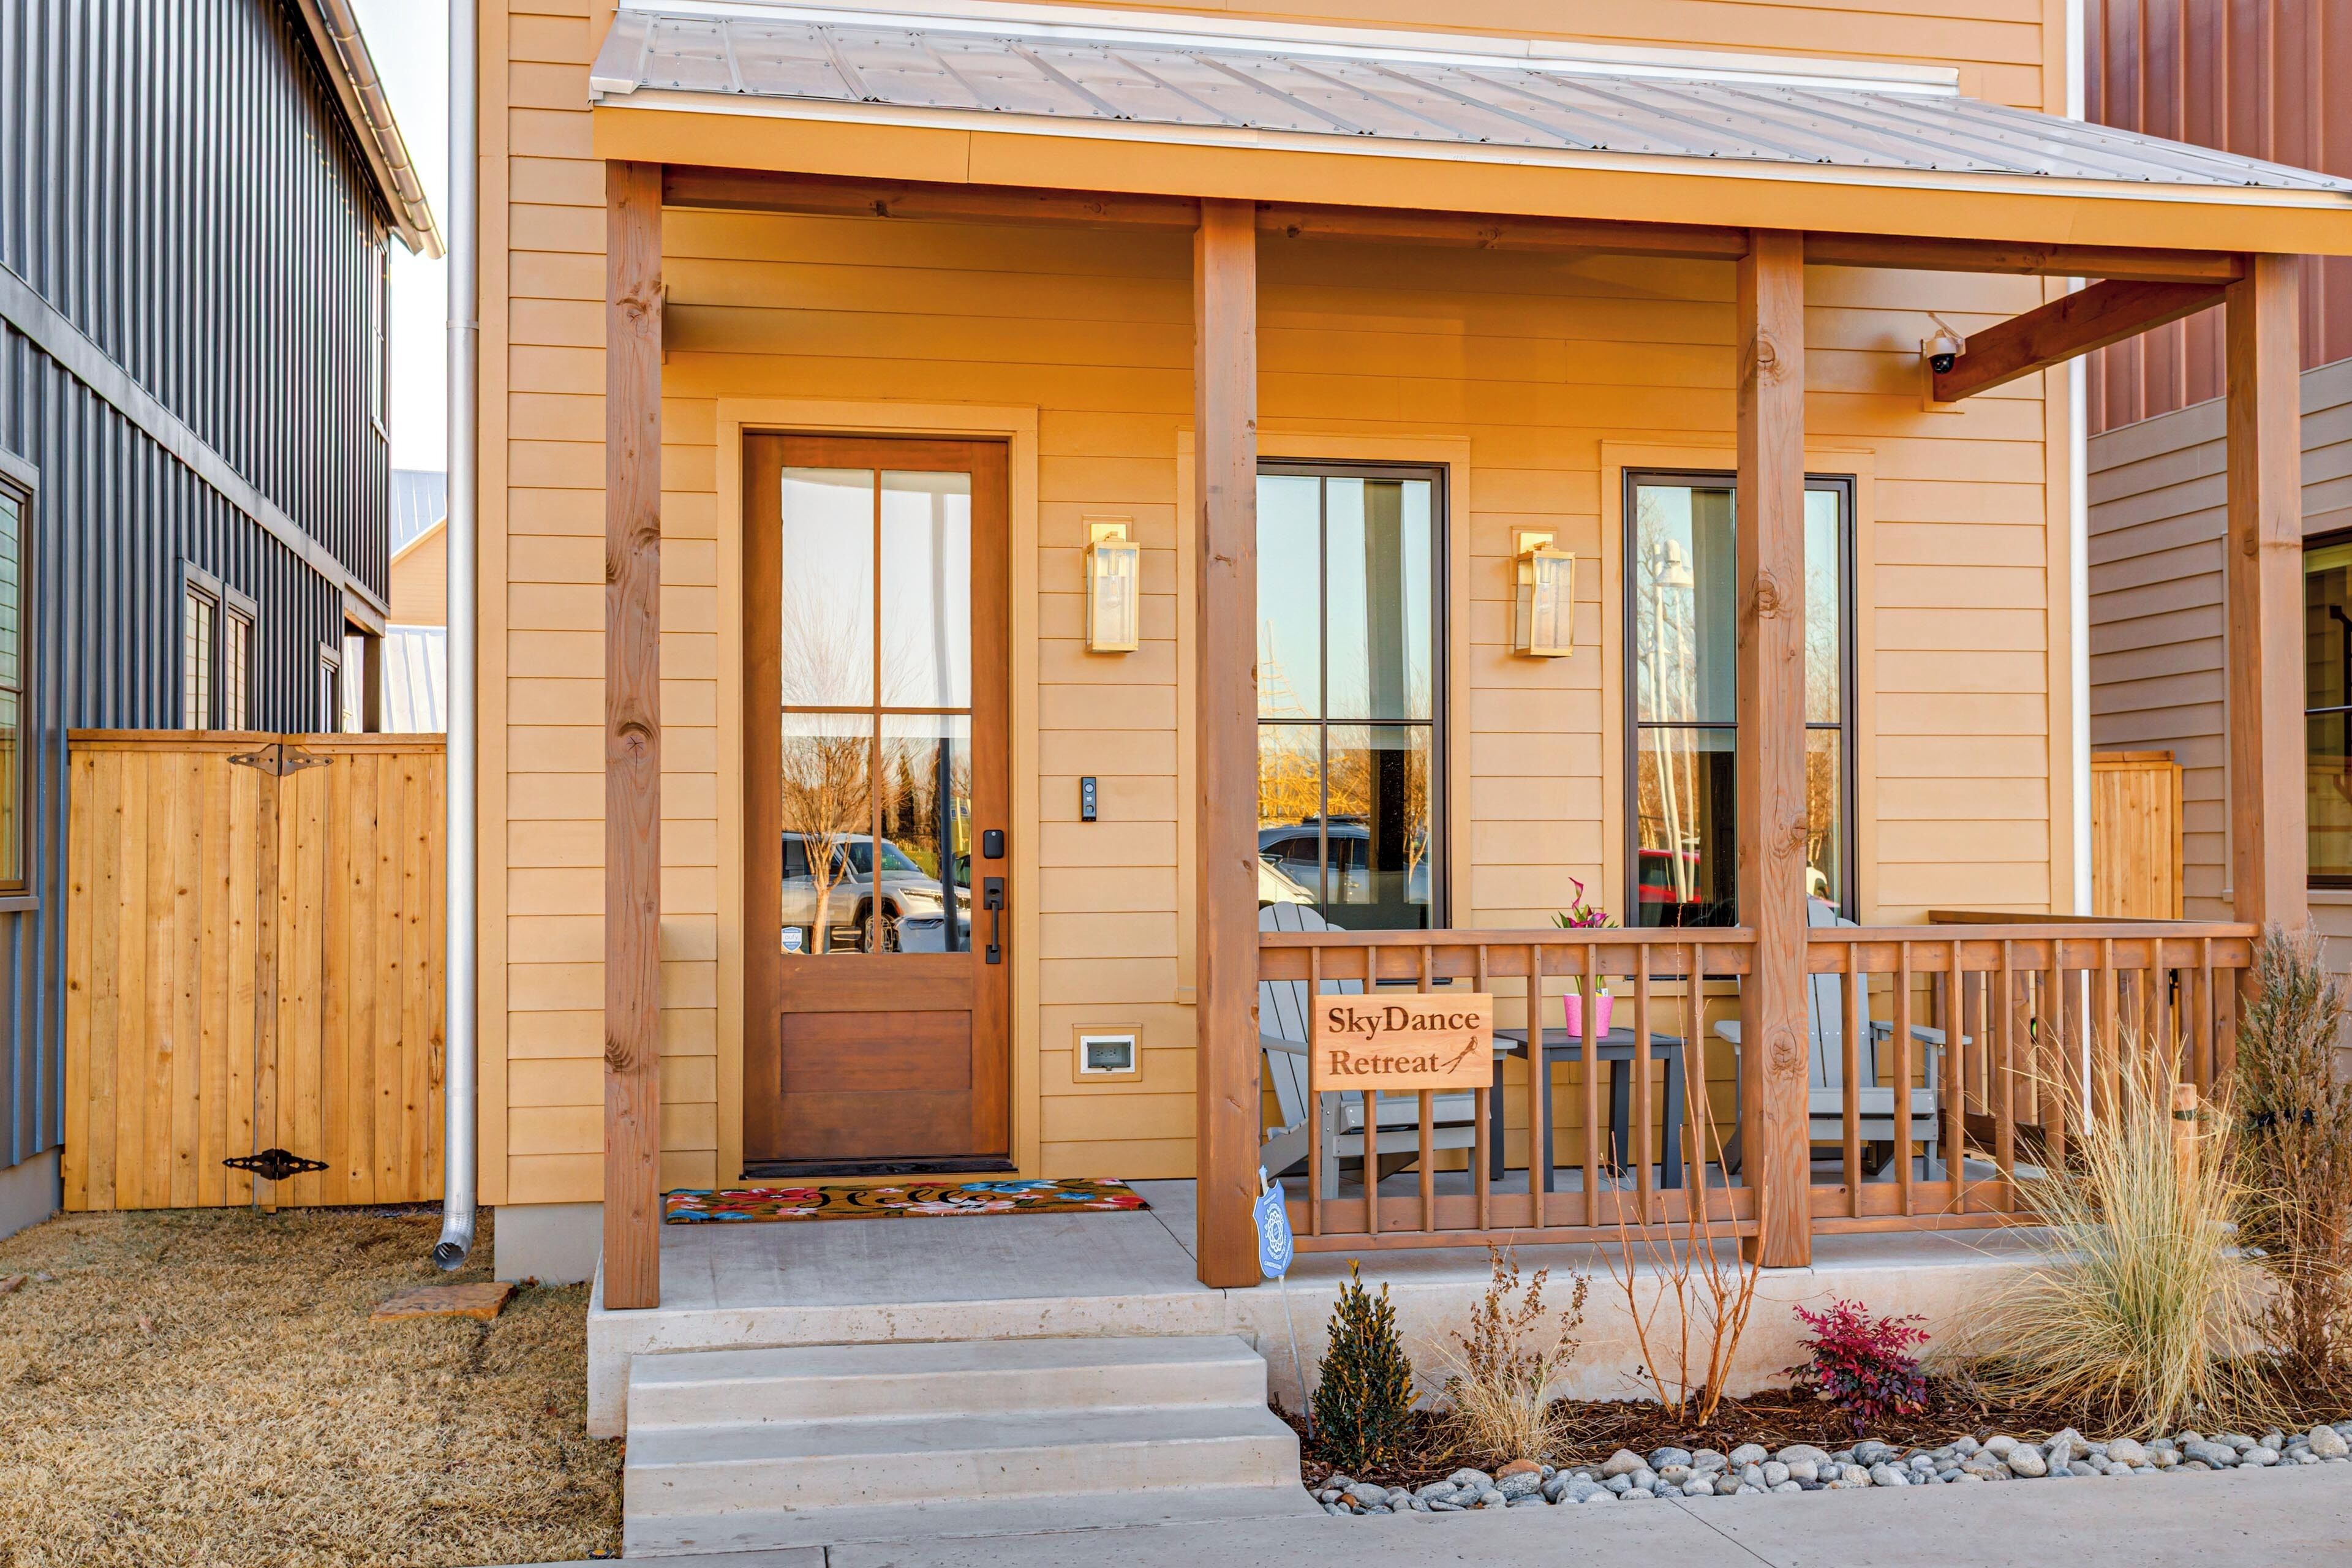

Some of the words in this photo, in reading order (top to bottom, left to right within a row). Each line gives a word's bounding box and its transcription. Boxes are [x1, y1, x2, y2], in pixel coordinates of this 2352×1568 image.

[1329, 1006, 1480, 1041] SkyDance
[1329, 1050, 1439, 1075] Retreat
[796, 1189, 997, 1208] Hello
